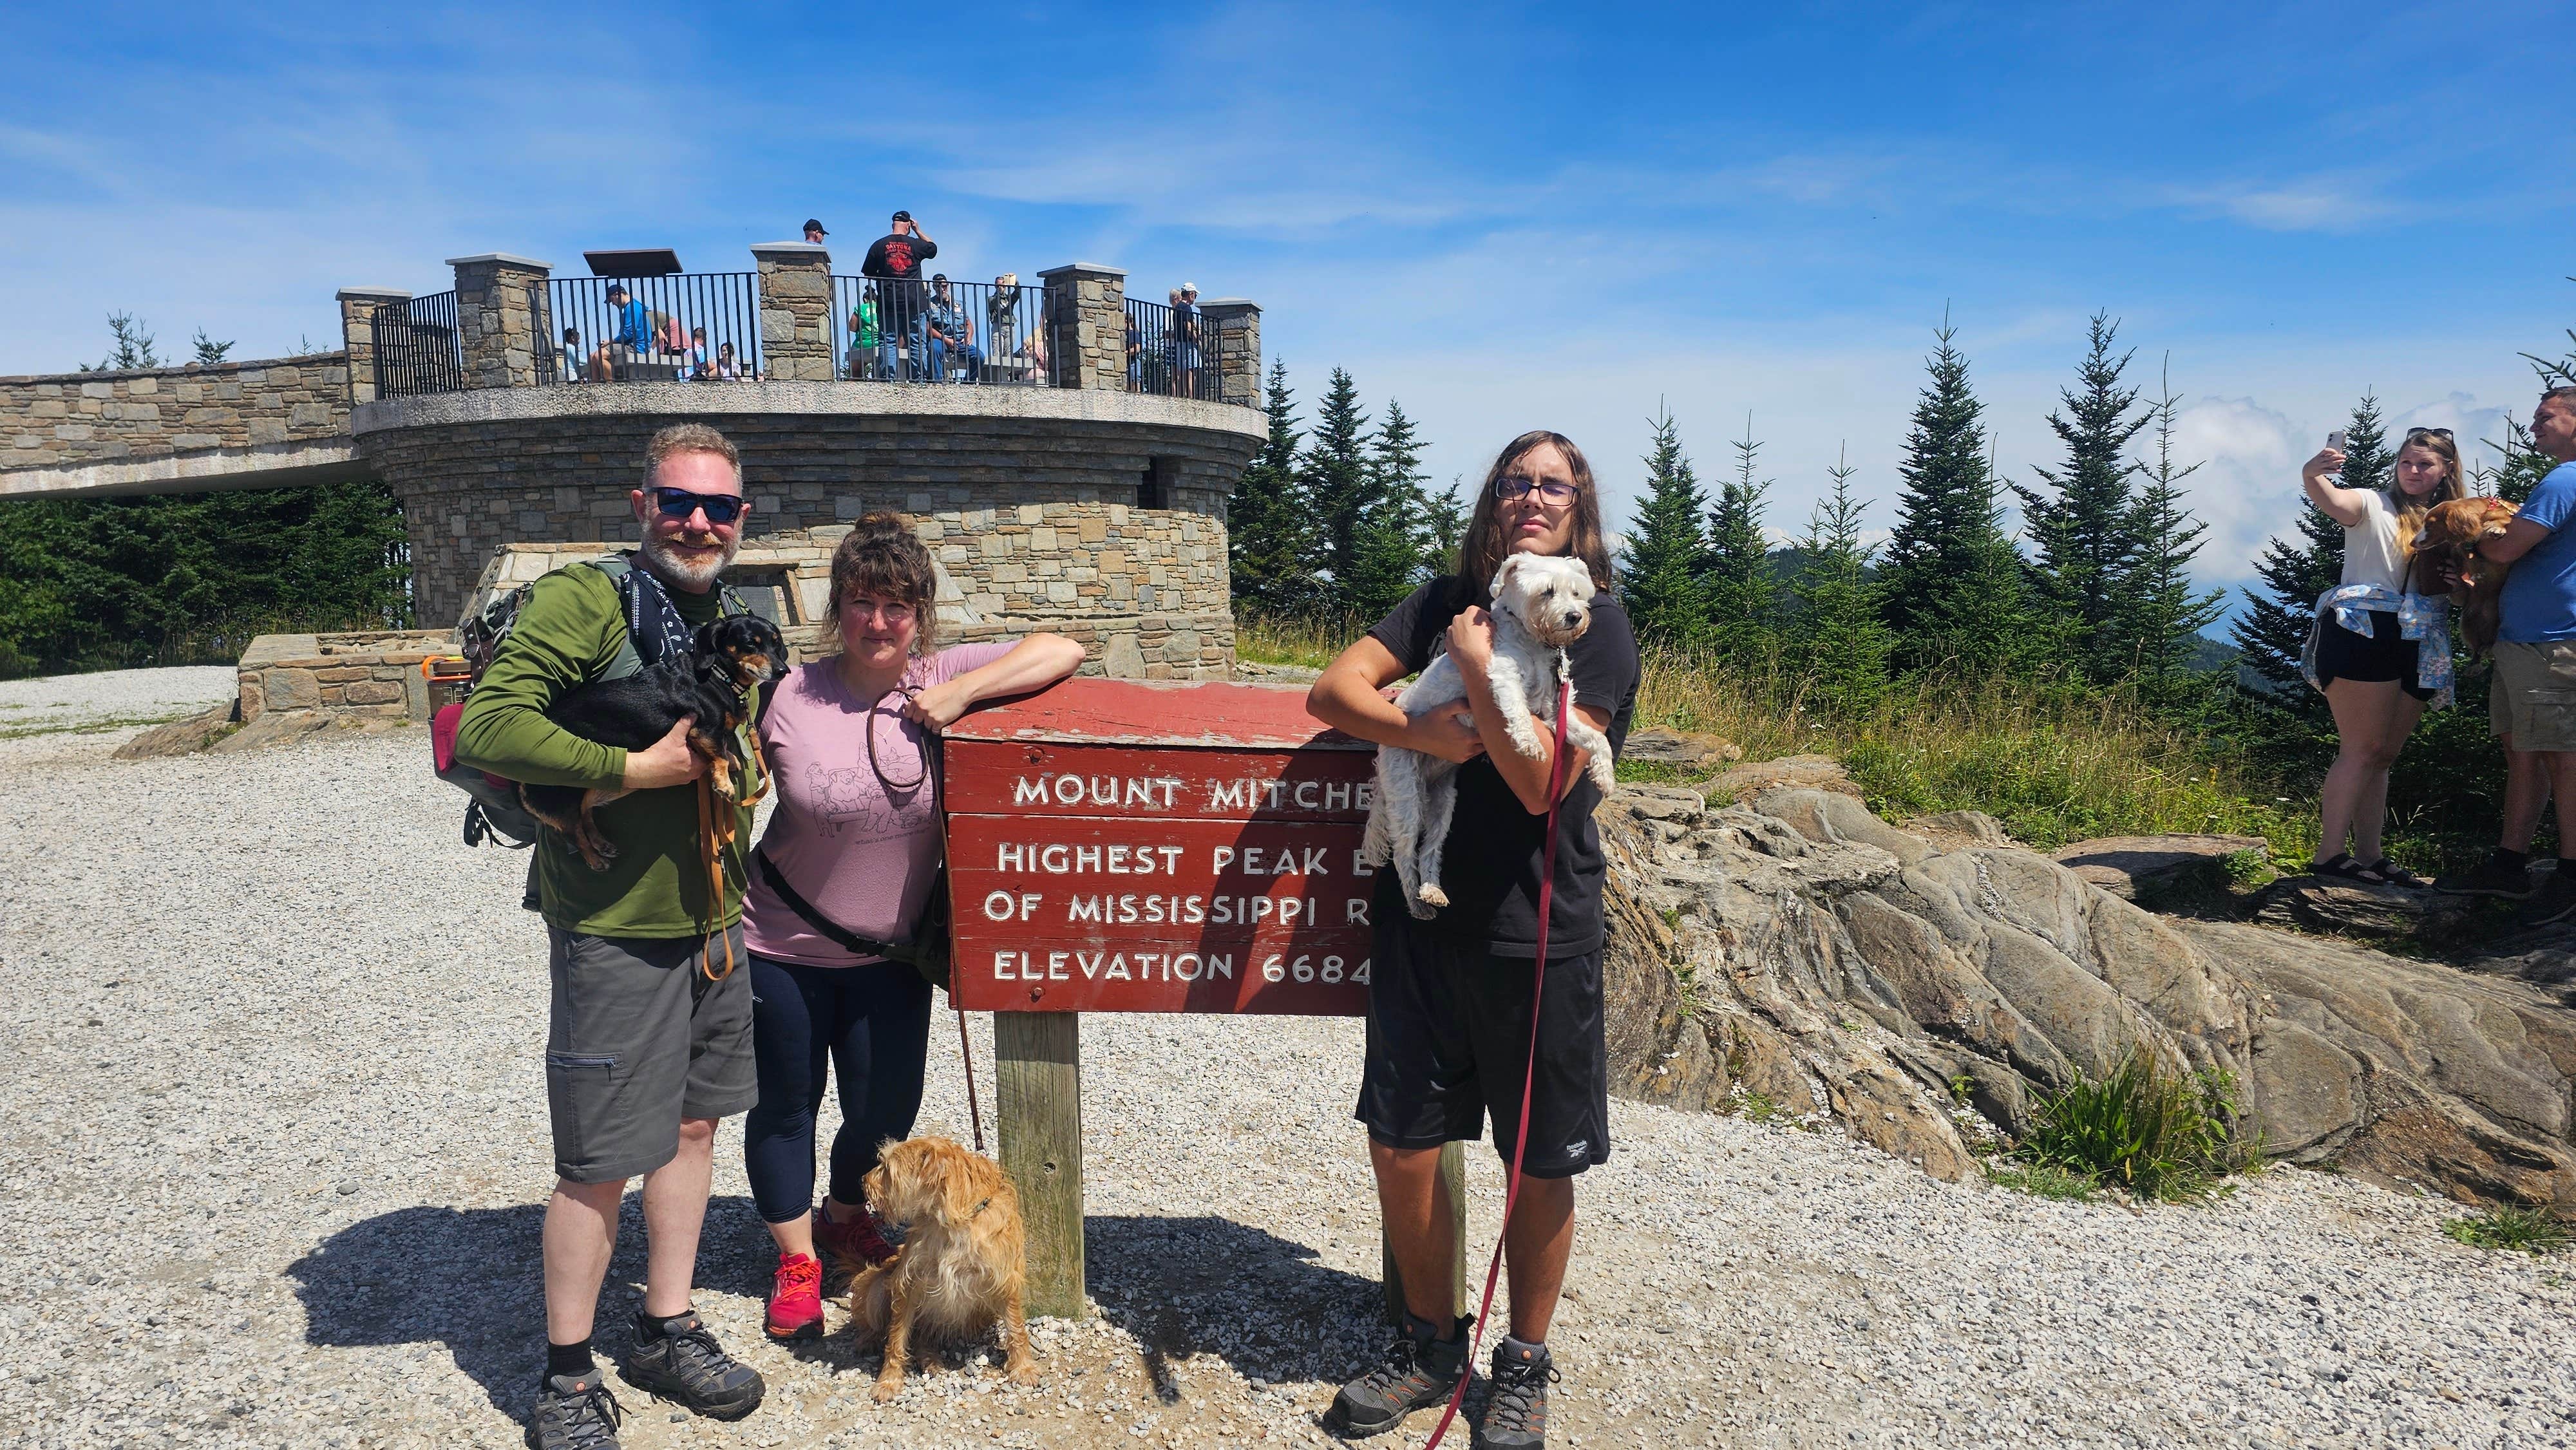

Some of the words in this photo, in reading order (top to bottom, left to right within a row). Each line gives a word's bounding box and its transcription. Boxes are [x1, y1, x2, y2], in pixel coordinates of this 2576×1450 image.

[1015, 774, 1181, 806] MOUNT
[1212, 778, 1371, 810] MITCHE
[998, 843, 1183, 875] HIGHEST
[1213, 847, 1329, 875] PEAK
[1353, 849, 1373, 876] E
[984, 890, 1042, 921] OF
[1069, 894, 1315, 926] MISSISSIPPI
[1347, 899, 1370, 926] R
[994, 952, 1231, 981] ELEVATION
[1263, 954, 1370, 985] 6684
[1566, 1140, 1587, 1151] Reebok
